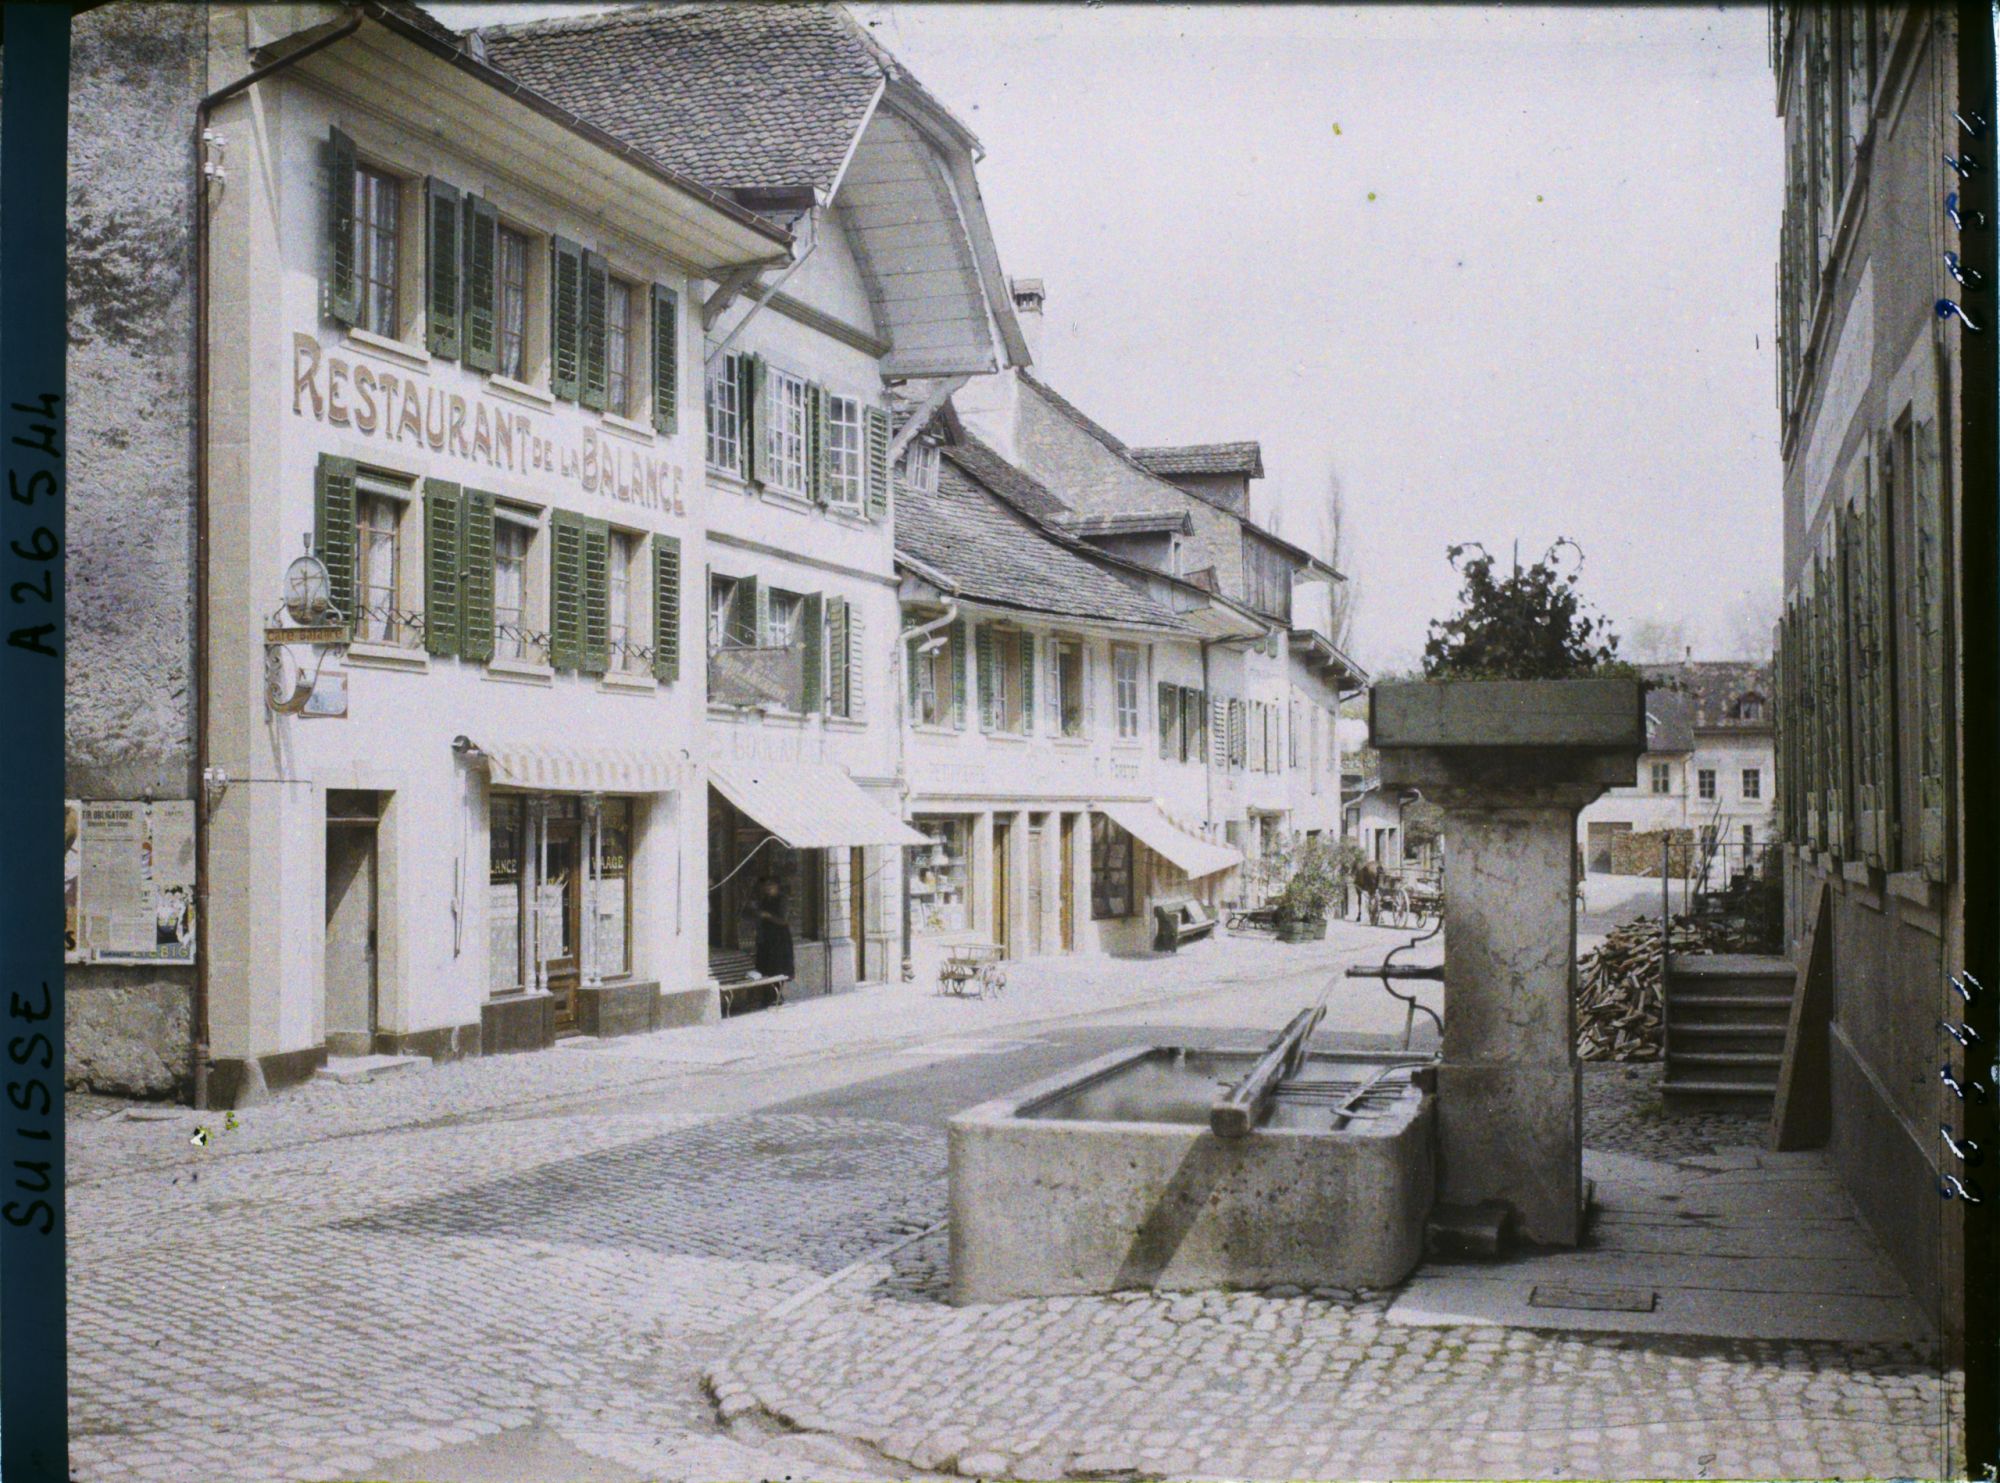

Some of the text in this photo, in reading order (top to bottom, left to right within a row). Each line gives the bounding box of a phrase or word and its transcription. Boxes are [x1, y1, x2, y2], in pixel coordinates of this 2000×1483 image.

[292, 333, 685, 516] RESTAURANT DE LA BALANCE
[1, 981, 56, 1236] SUISSE
